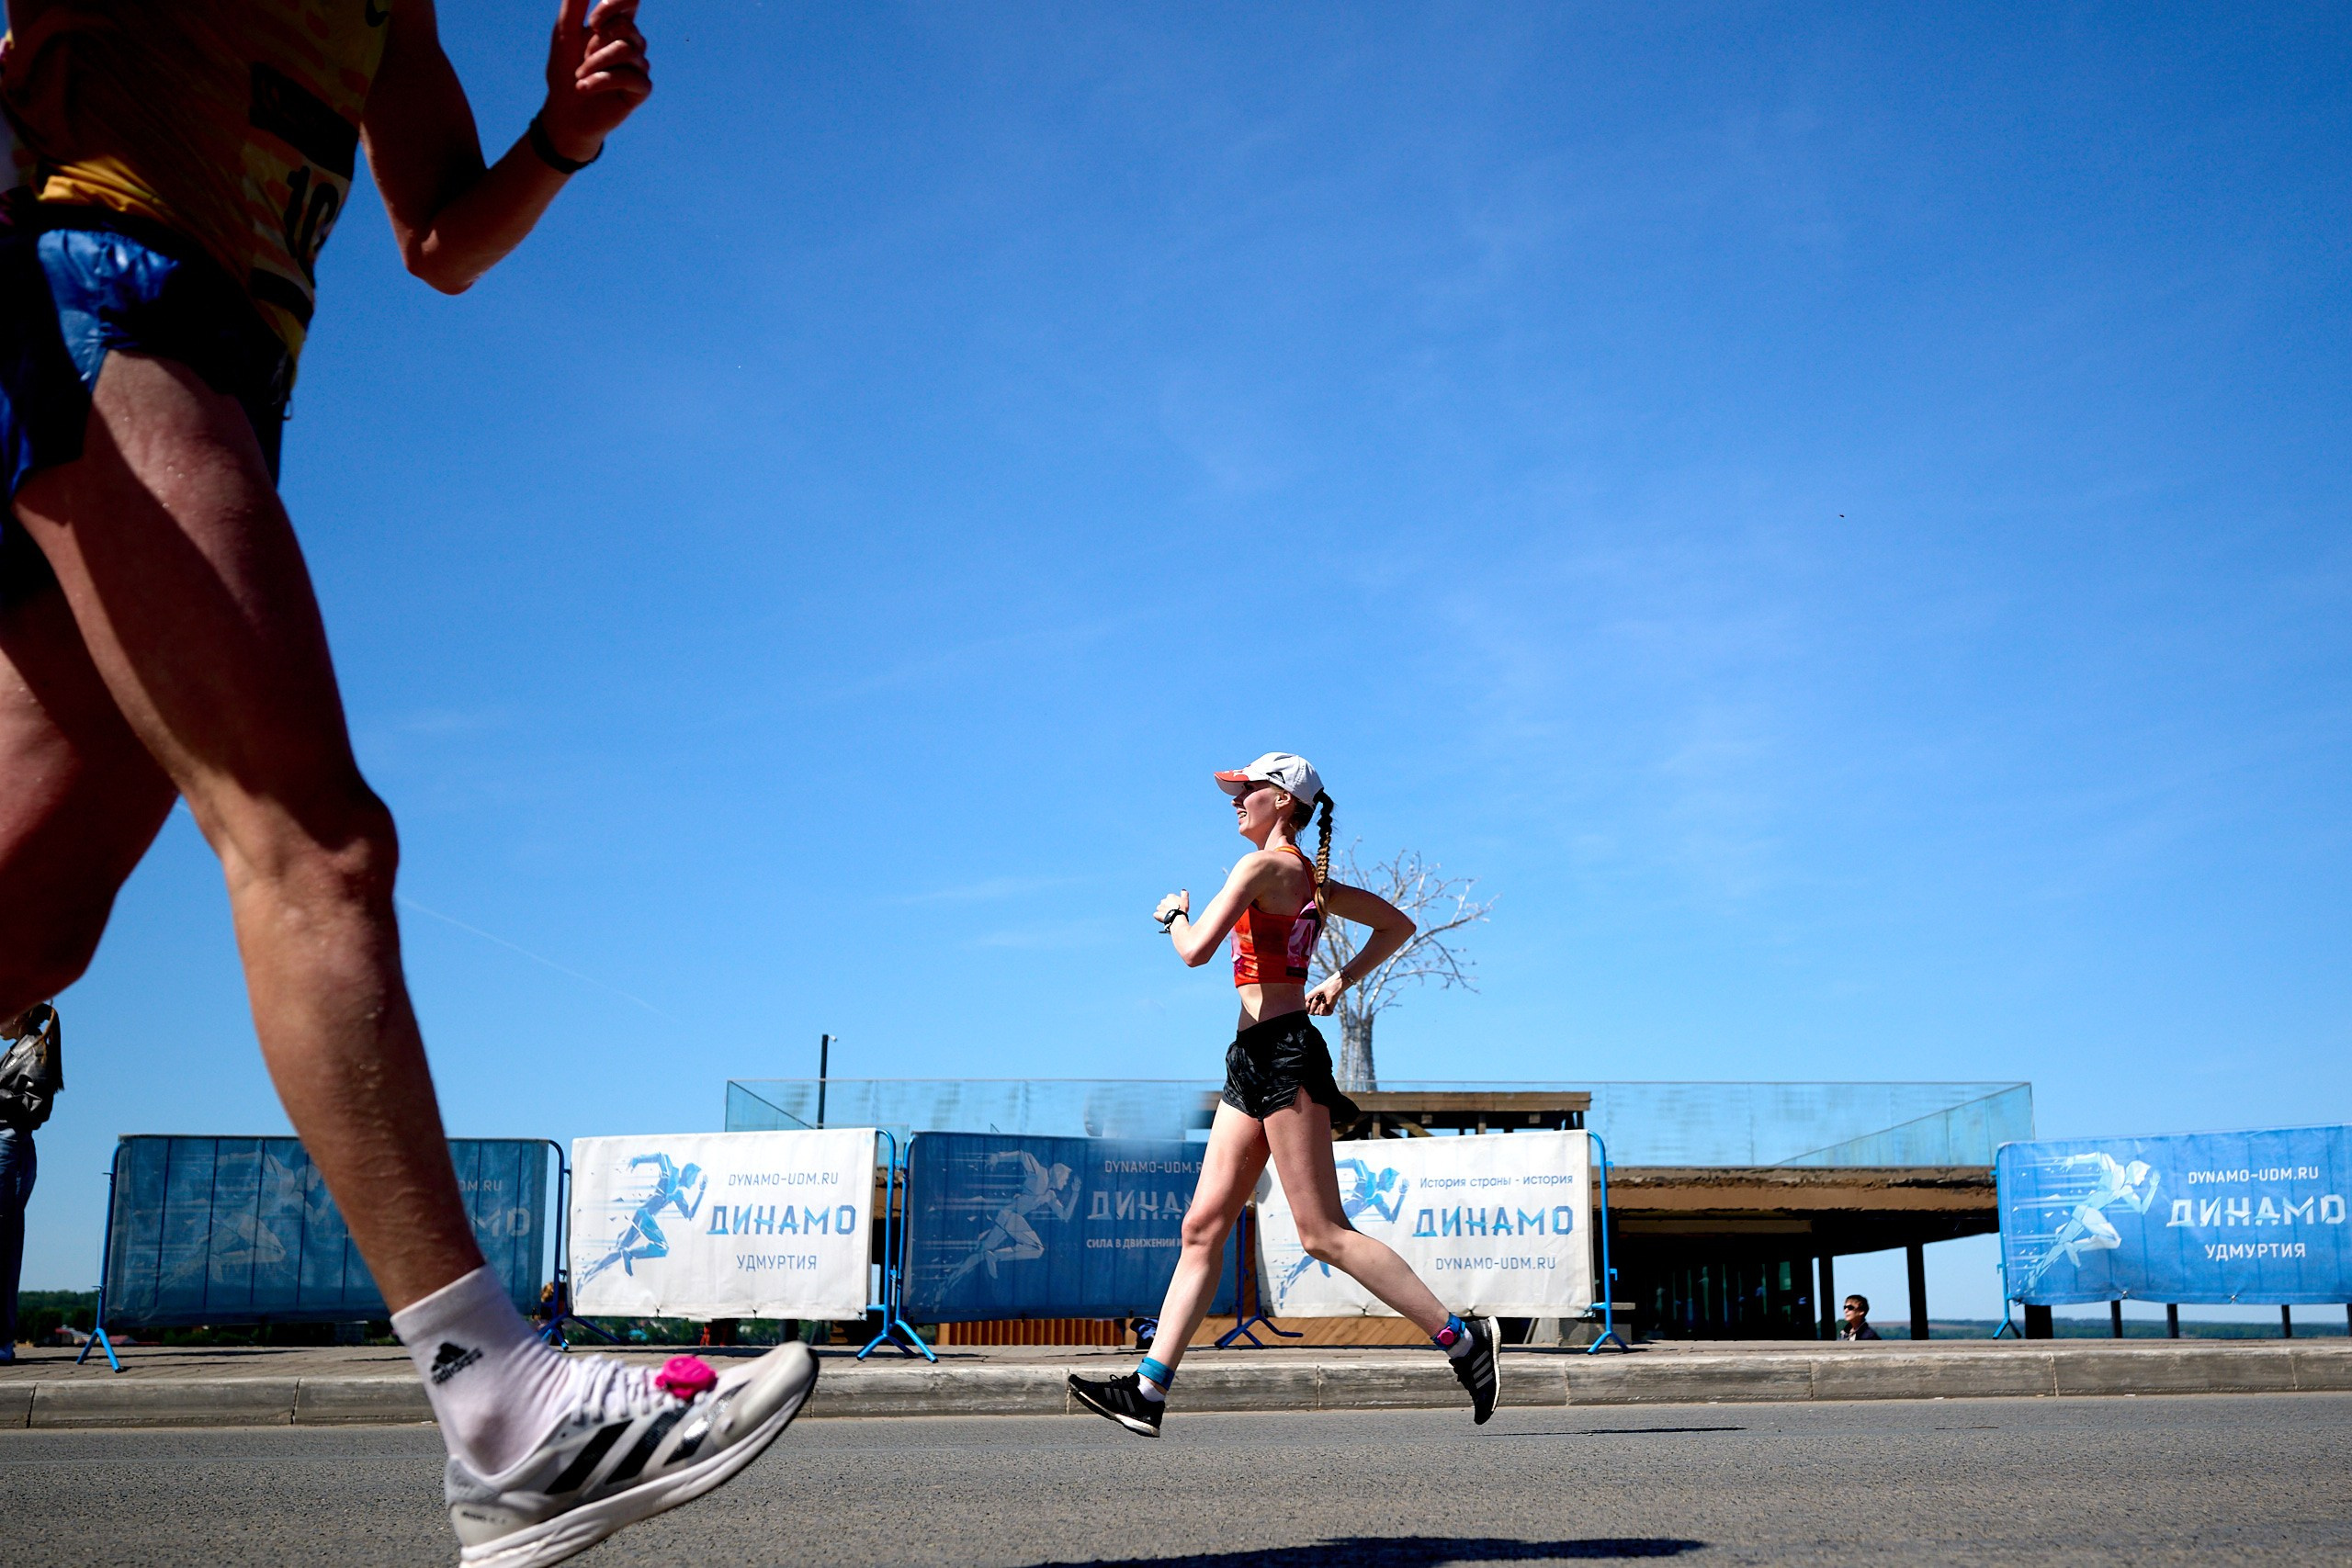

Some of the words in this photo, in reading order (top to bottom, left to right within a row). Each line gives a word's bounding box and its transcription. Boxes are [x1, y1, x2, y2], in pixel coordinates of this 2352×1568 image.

[728, 1172, 839, 1186] DYNAMO-UDM.RU
[1419, 1177, 1466, 1190] История
[1469, 1177, 1511, 1189] страны
[1522, 1174, 1573, 1186] история
[2188, 1167, 2319, 1185] DYNAMO-UDM.RU
[706, 1203, 856, 1235] ДИНАМО
[2165, 1193, 2346, 1228] ДИНАМО
[1411, 1205, 1574, 1237] ДИНАМО
[1086, 1238, 1114, 1248] СИЛА
[1115, 1238, 1122, 1248] В
[1123, 1238, 1176, 1250] ДВИЖЕНИИ
[2204, 1243, 2306, 1262] УДМУРТИЯ
[736, 1255, 817, 1272] УДМУРТИЯ
[1435, 1257, 1556, 1270] DYNAMO-UDM.RU
